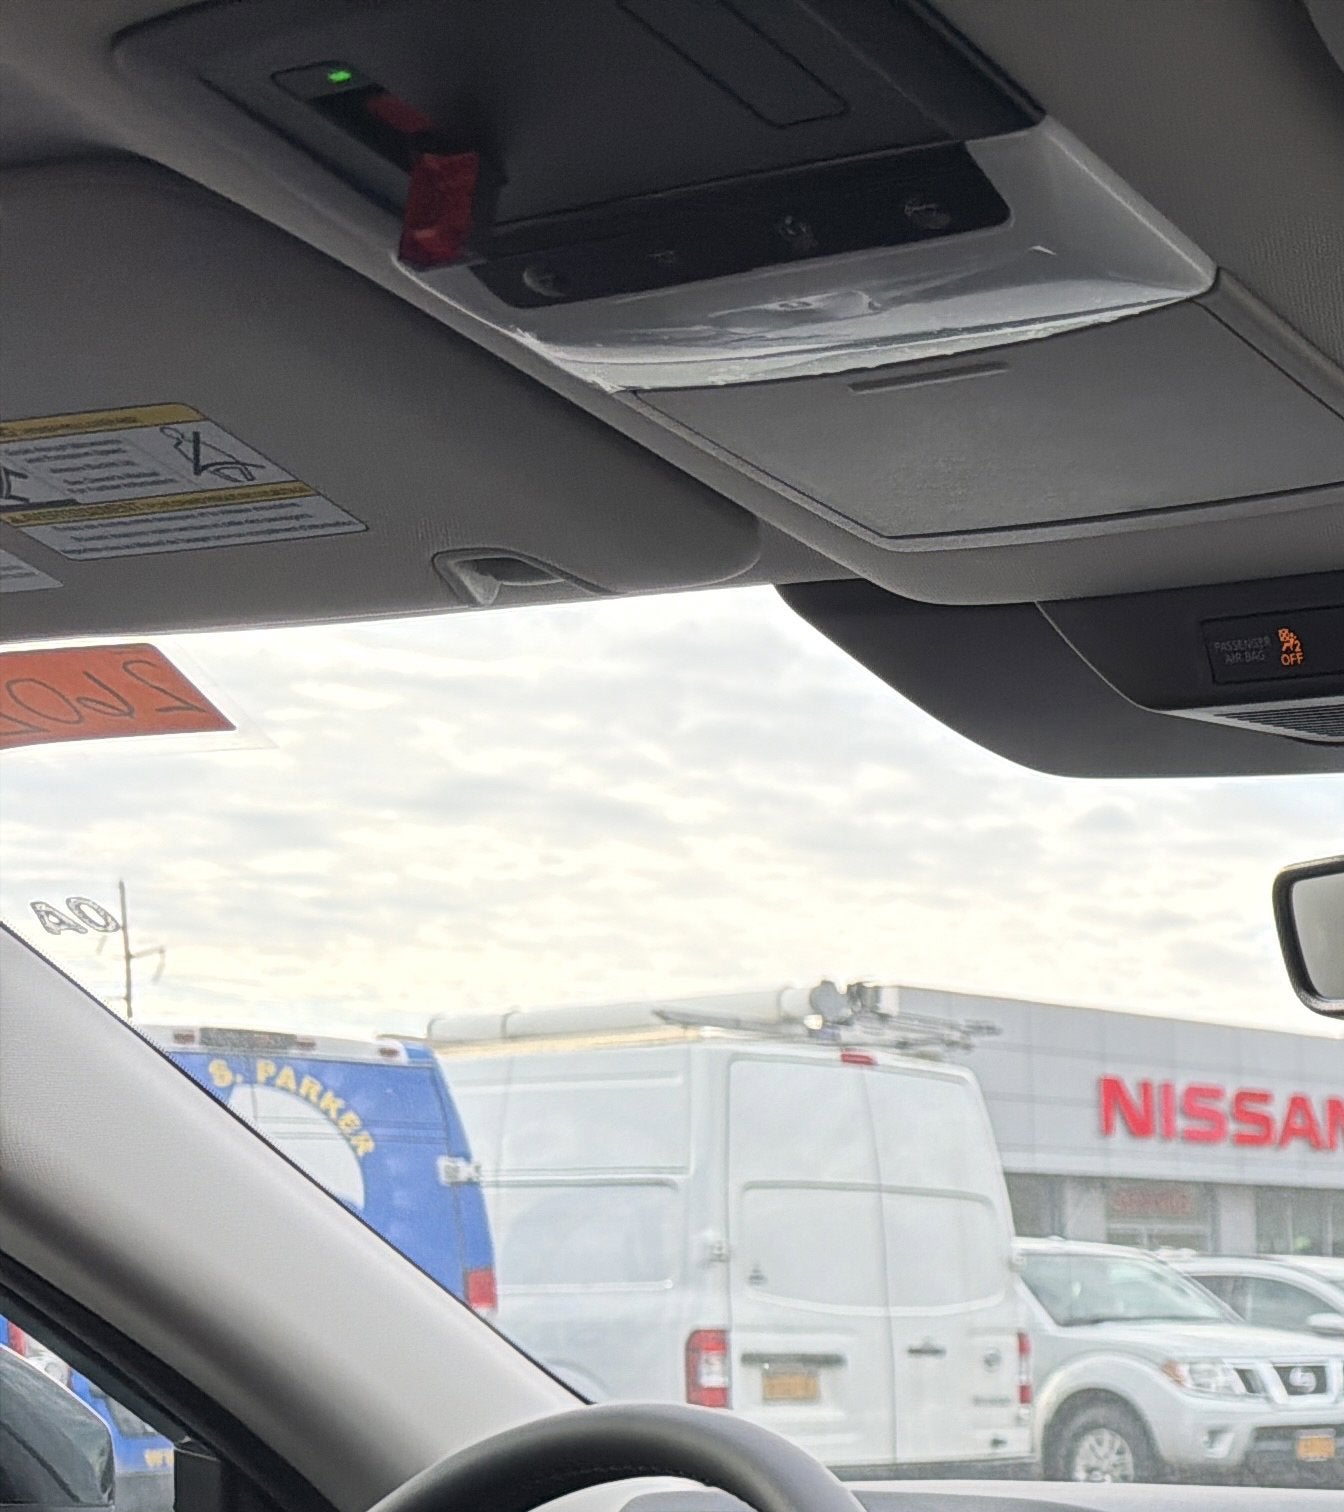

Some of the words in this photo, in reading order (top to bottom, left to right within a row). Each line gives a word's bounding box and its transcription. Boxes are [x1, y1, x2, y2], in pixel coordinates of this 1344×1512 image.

[1214, 637, 1271, 653] PASSENGER
[1280, 652, 1303, 666] OFF
[256, 1058, 375, 1158] PARKER
